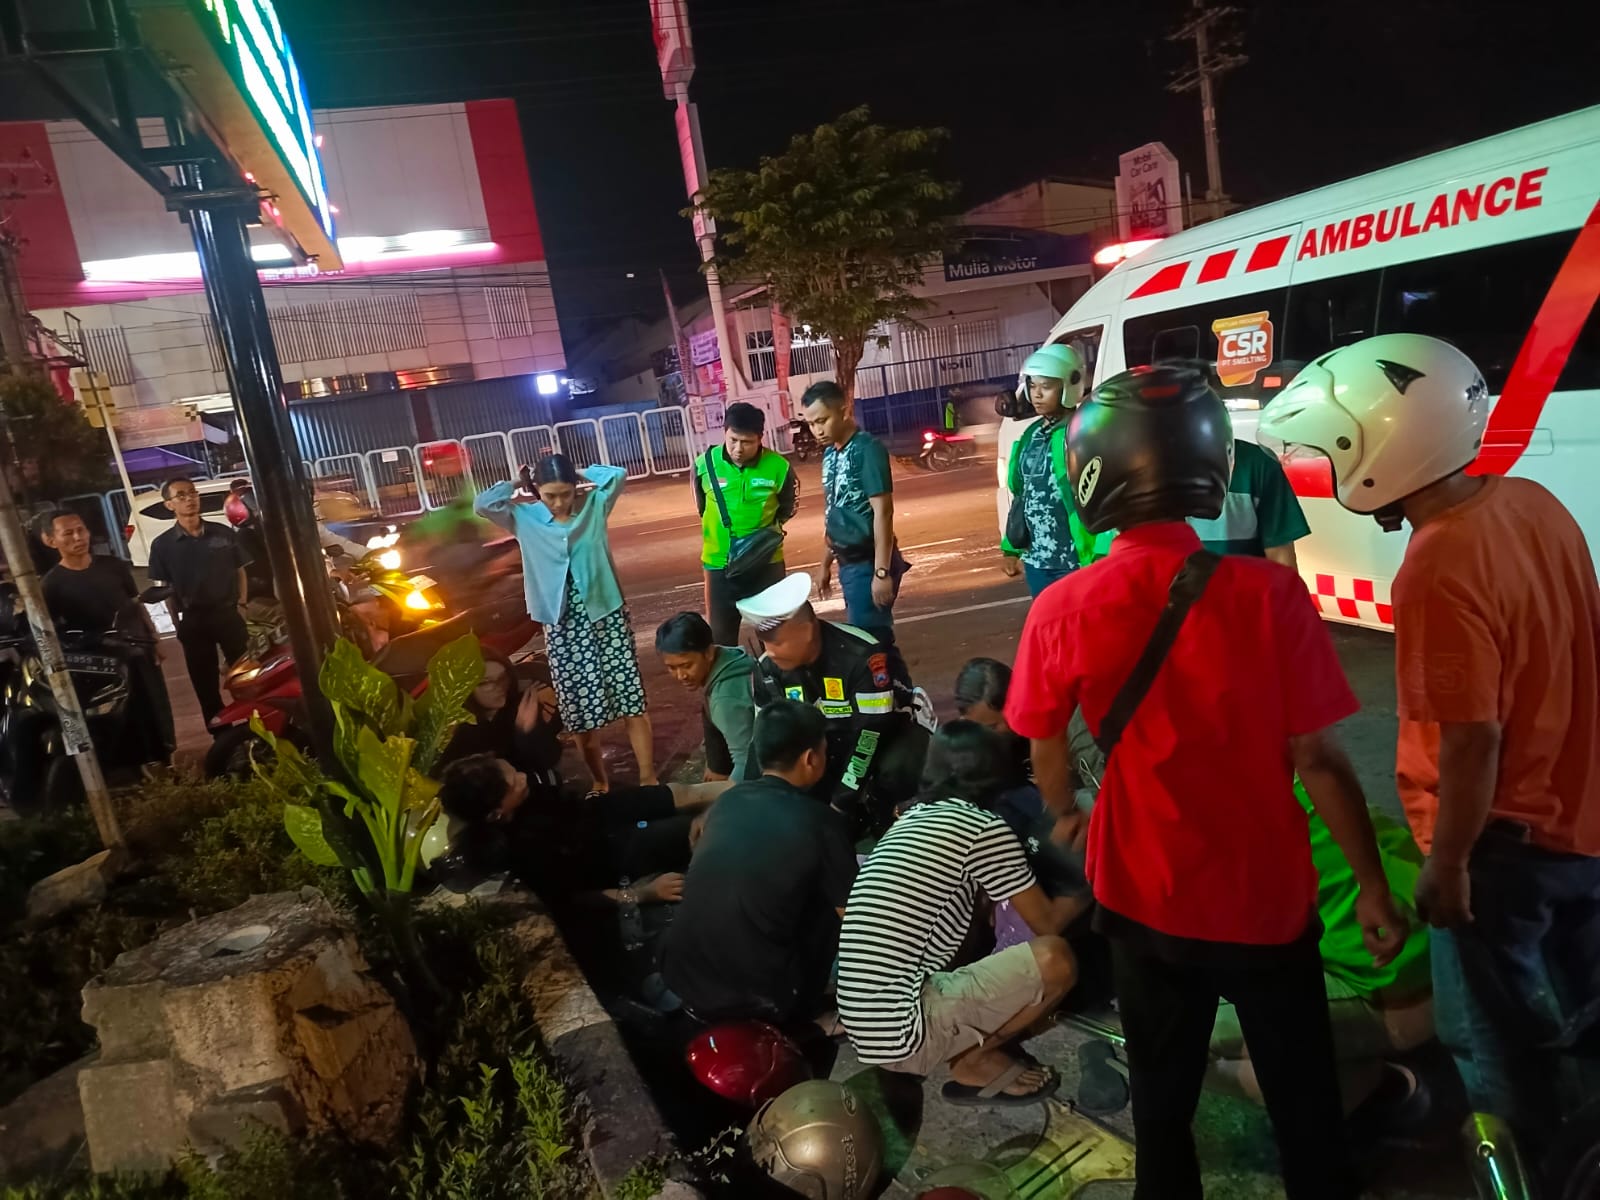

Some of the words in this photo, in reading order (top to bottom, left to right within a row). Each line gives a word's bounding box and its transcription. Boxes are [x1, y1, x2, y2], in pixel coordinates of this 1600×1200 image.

[1297, 167, 1549, 261] AMBULANCE
[1222, 330, 1268, 358] CSR
[1232, 354, 1267, 366] SMELTING
[1079, 462, 1097, 502] INK
[841, 729, 881, 791] POLISI
